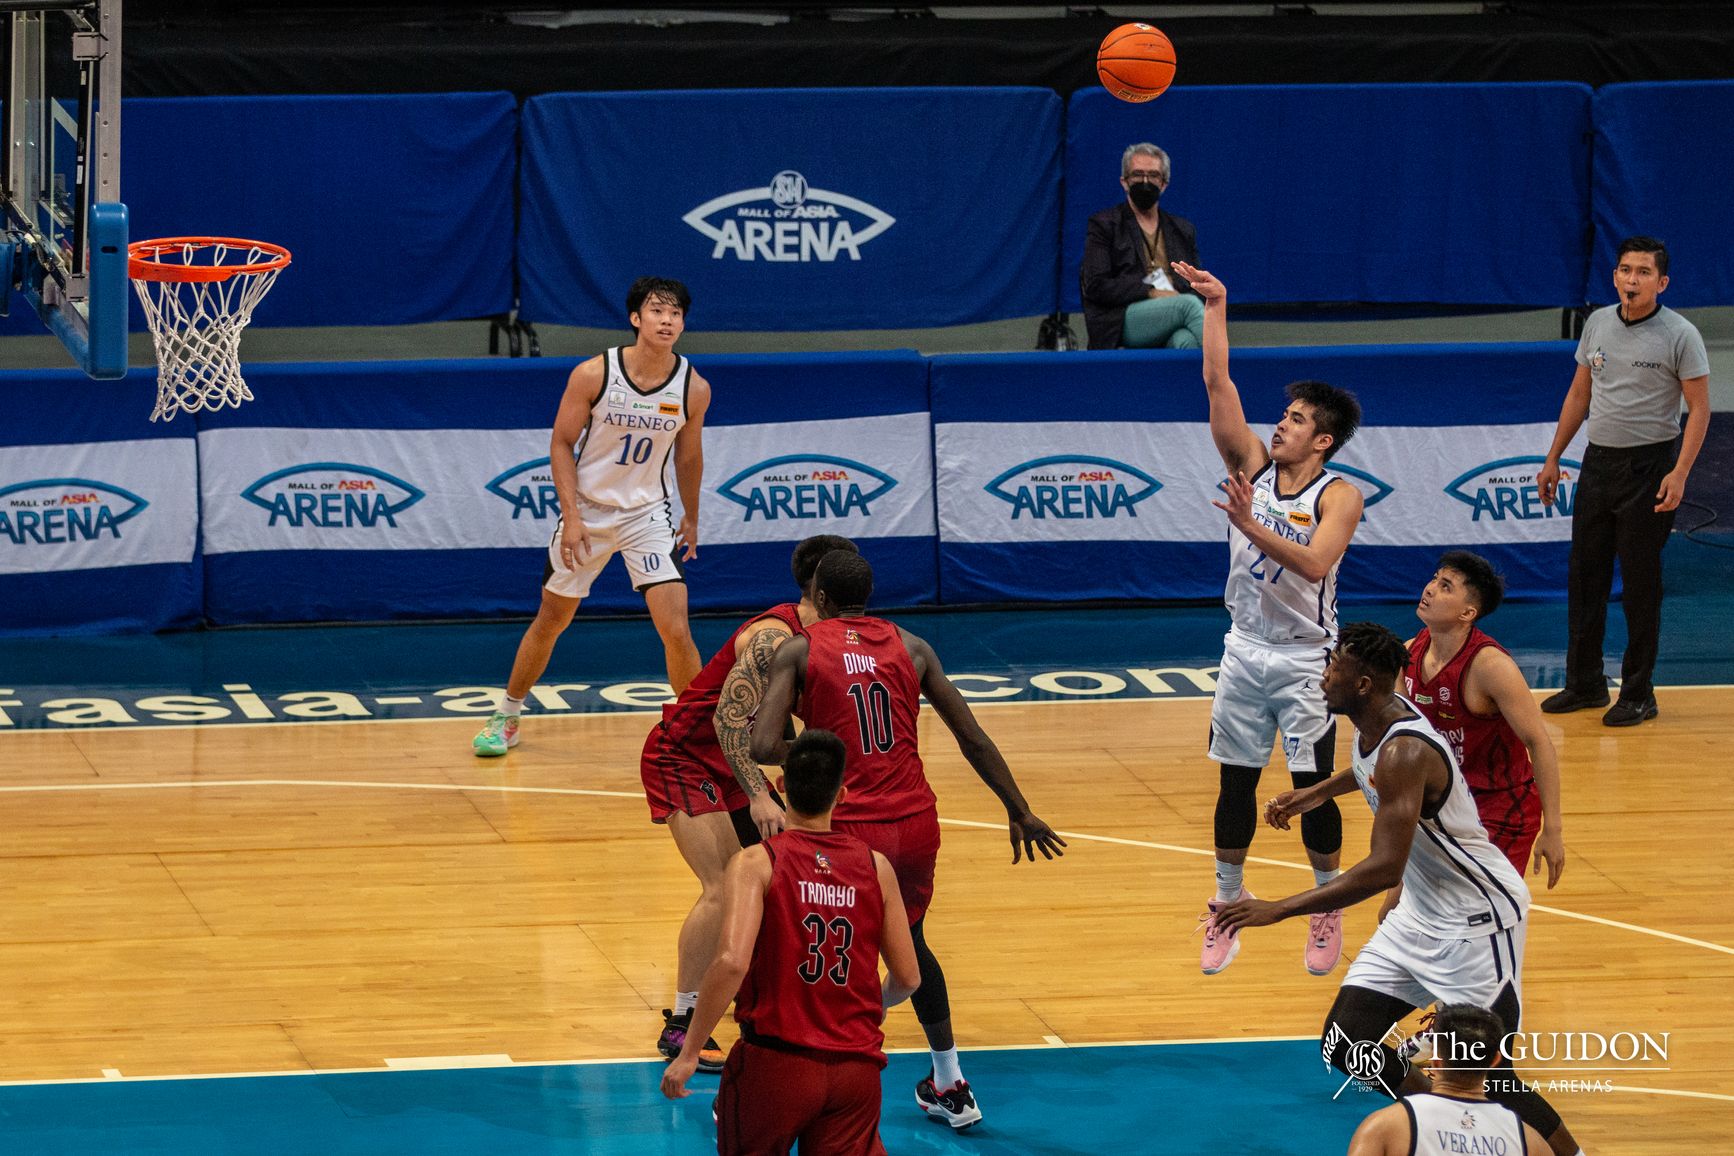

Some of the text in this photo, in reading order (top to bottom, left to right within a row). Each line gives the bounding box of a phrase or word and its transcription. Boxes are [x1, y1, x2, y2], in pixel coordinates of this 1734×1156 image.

[737, 205, 841, 218] MALL OF ASIA
[712, 218, 862, 262] ARENA
[1632, 360, 1661, 368] JOCKEY
[603, 412, 677, 432] ATENEO
[615, 433, 653, 466] 10
[338, 480, 377, 490] ASIA
[811, 471, 849, 481] ASIA
[1078, 471, 1115, 481] ASIA
[60, 493, 99, 505] ASIA
[268, 492, 398, 528] ARENA
[744, 483, 871, 522] ARENA
[1011, 483, 1137, 520] ARENA
[0, 505, 122, 545] ARENA
[1253, 512, 1311, 547] TENEO
[642, 552, 660, 573] 10
[846, 681, 895, 755] 10
[797, 880, 857, 908] TAMAYO
[797, 912, 854, 987] 33
[1436, 1129, 1507, 1156] VERANO
